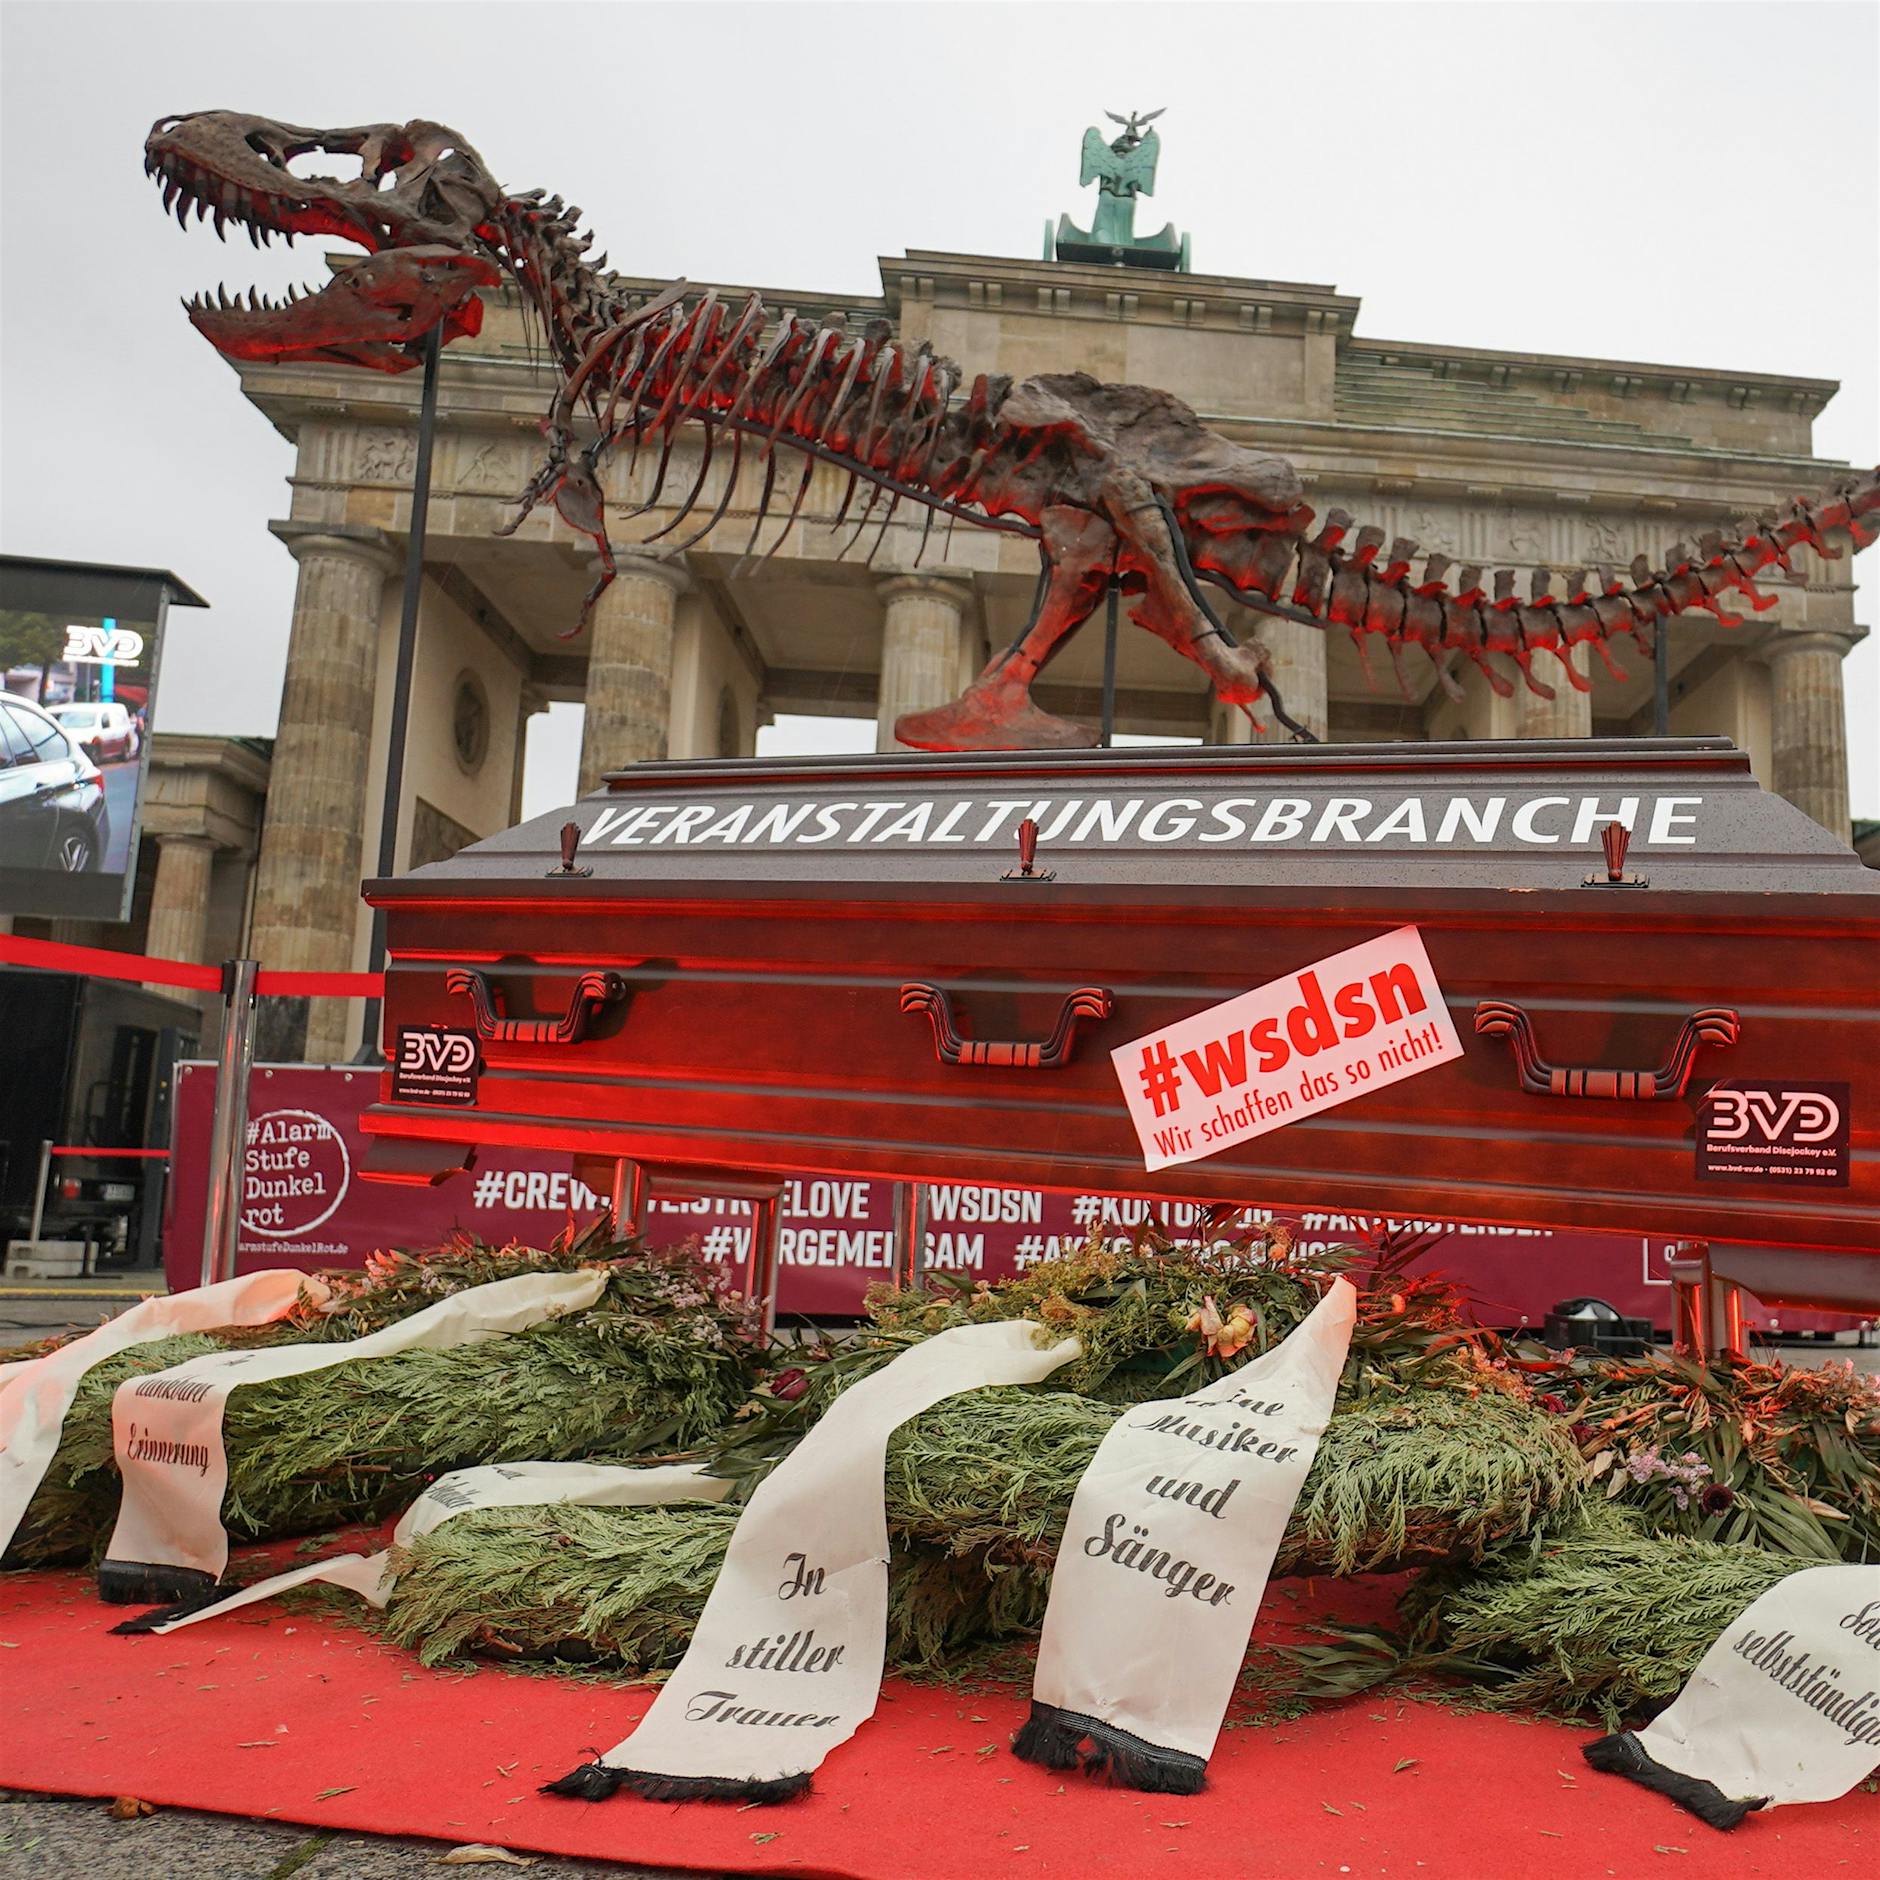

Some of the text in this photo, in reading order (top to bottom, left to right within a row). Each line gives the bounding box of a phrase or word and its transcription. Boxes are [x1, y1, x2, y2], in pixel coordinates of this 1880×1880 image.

[581, 796, 1702, 846] VERANSTALTUNGSBRANCHE
[1139, 962, 1428, 1118] #wsdsn
[1153, 1021, 1444, 1158] Wir schaffen das so nicht!
[246, 1120, 333, 1146] #Alarm
[246, 1147, 311, 1172] Stufe
[246, 1172, 327, 1200] Dunkel
[928, 1184, 1043, 1224] WSDSN
[245, 1202, 284, 1226] rot
[127, 1422, 211, 1477] Erinnerung
[1128, 1415, 1299, 1463] Musiker
[1145, 1475, 1241, 1520] und
[778, 1552, 827, 1601] In
[1084, 1513, 1236, 1606] Sänger
[725, 1630, 845, 1673] stiller
[684, 1690, 840, 1728] Trauer
